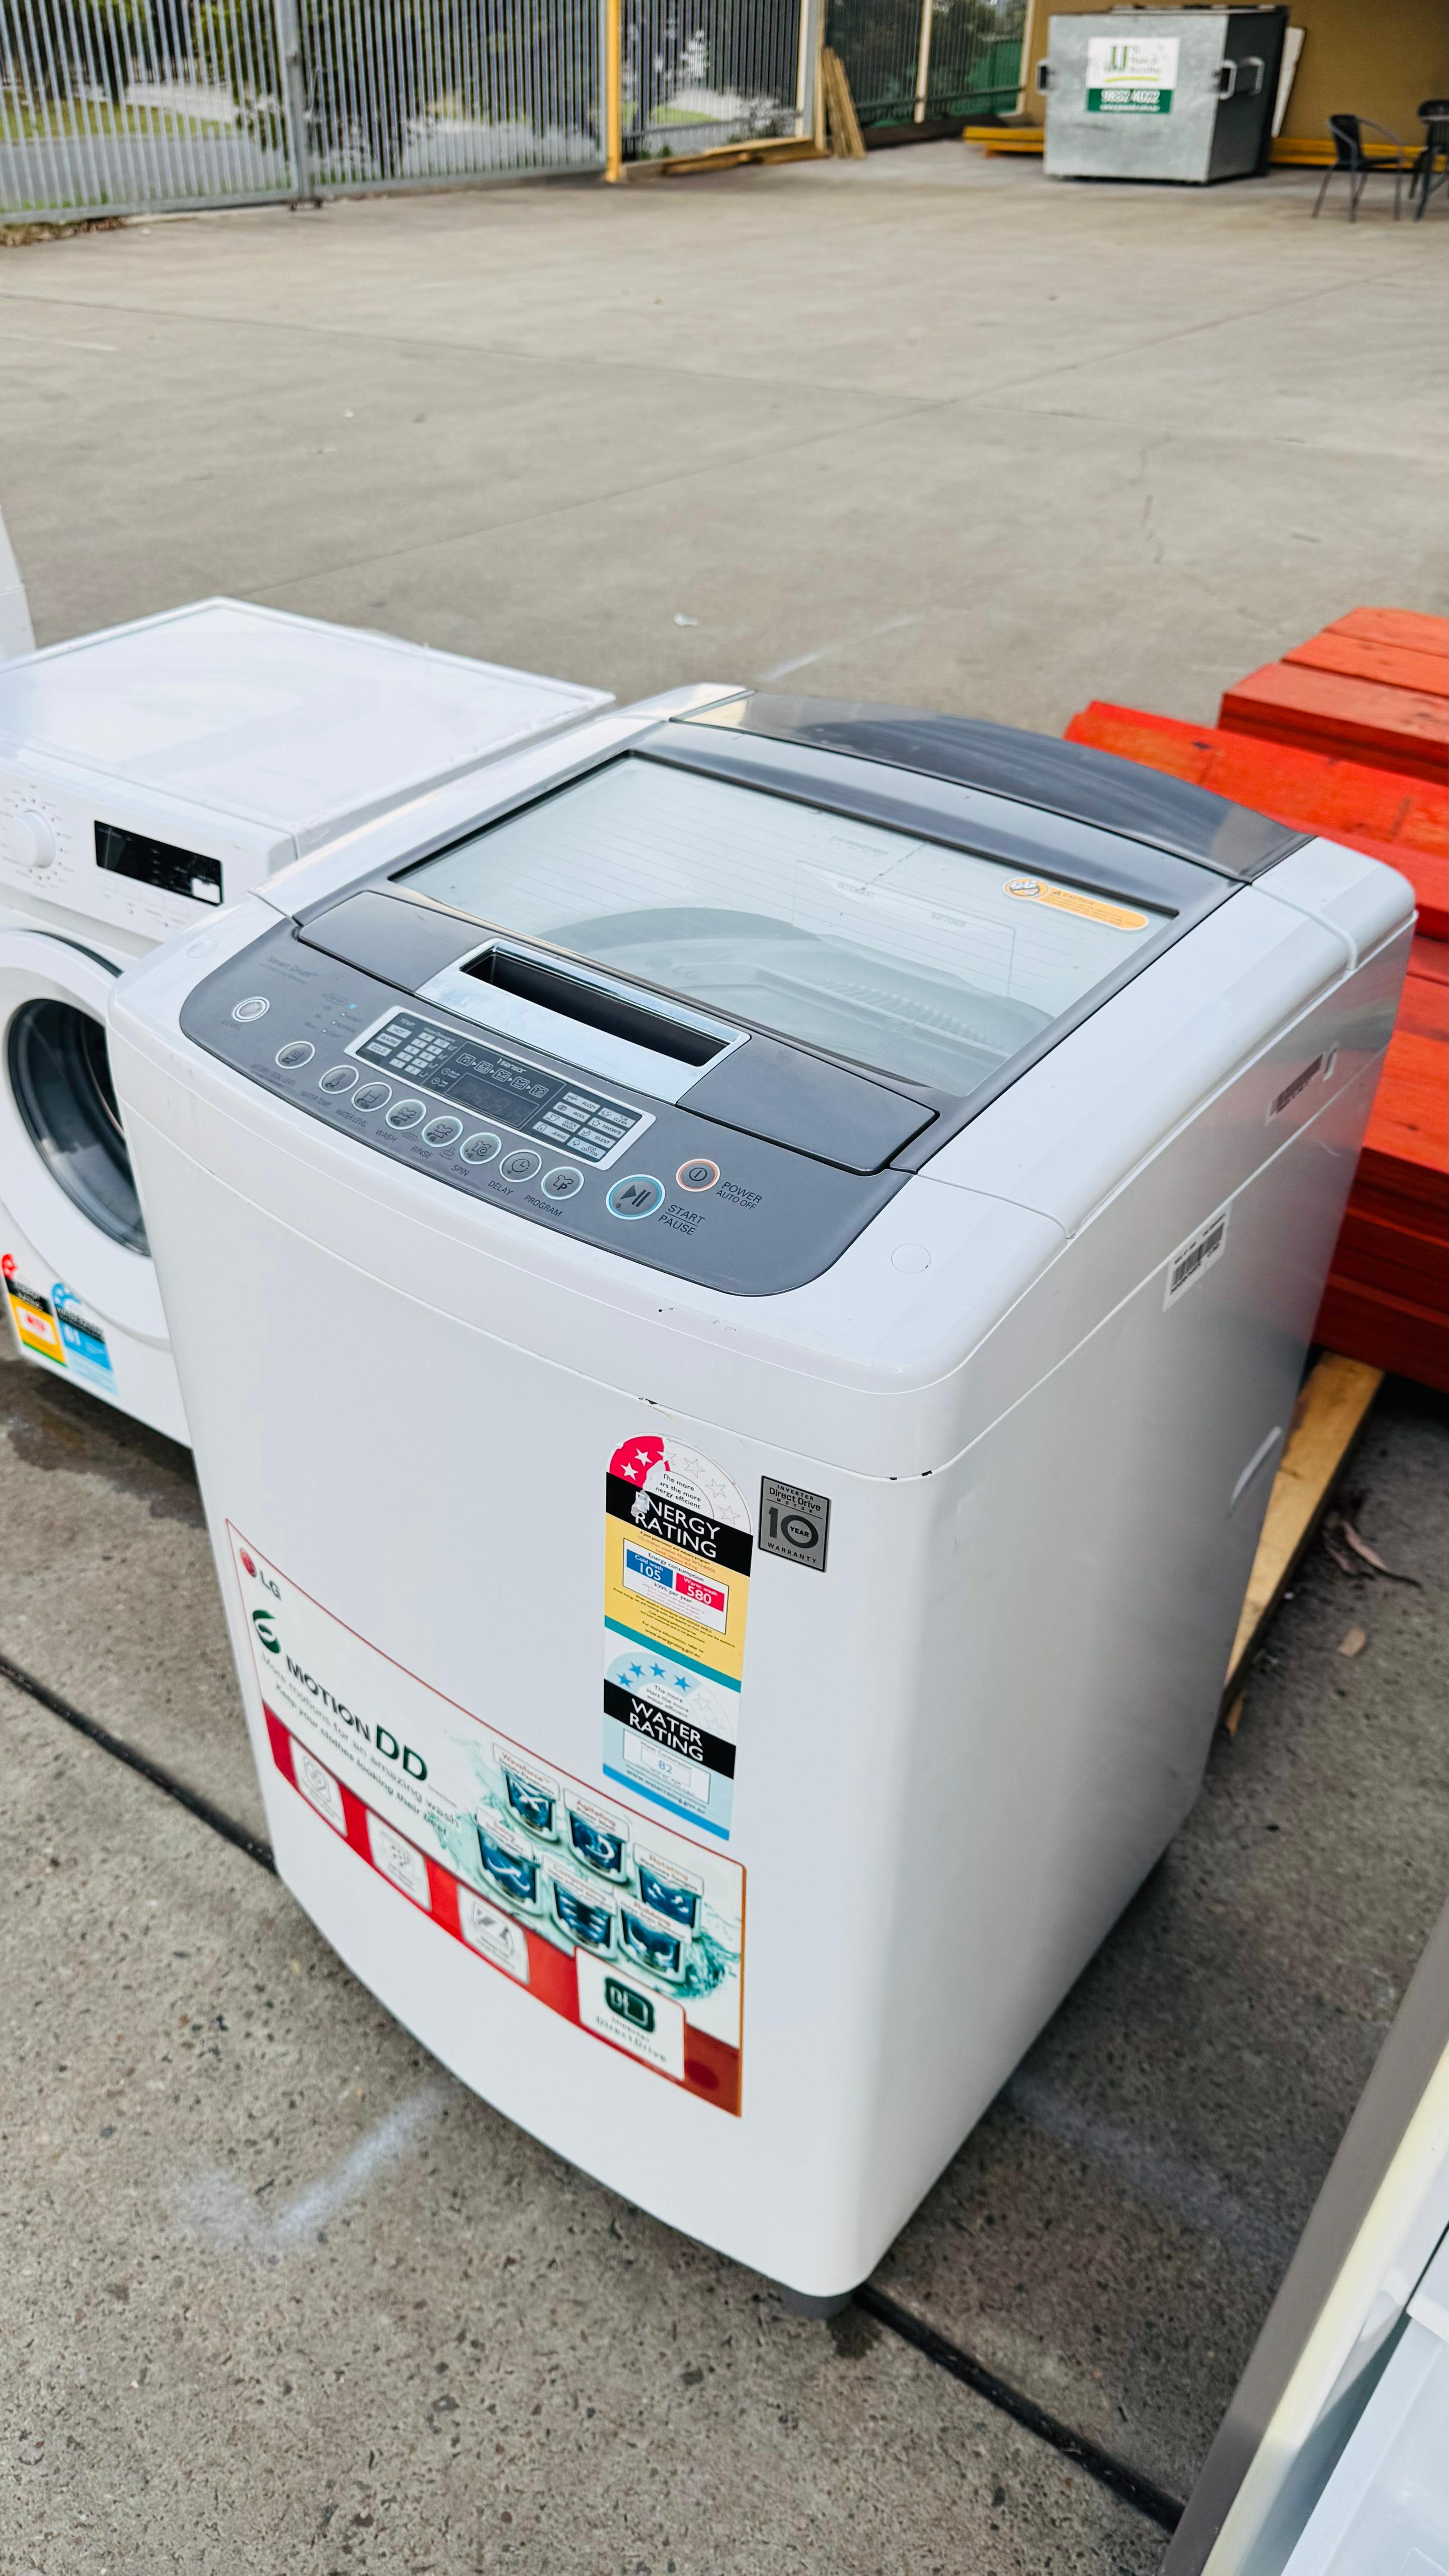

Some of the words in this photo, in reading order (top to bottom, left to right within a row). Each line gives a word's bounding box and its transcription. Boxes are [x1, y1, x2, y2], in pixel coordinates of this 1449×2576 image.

[380, 1034, 398, 1044] WARM
[371, 1045, 387, 1054] COLD
[582, 1101, 596, 1110] FUZZY
[335, 1108, 354, 1122] WATER
[352, 1115, 369, 1128] LEVEL
[573, 1111, 586, 1119] WOOL
[613, 1116, 628, 1125] CLEAN
[375, 1129, 398, 1143] WASH
[551, 1131, 567, 1140] JEANS
[602, 1124, 622, 1135] FAVORITE
[594, 1135, 610, 1145] SILENT
[411, 1146, 434, 1159] RINSE
[581, 1147, 599, 1157] COTTON
[451, 1164, 470, 1177] SPIN
[488, 1180, 514, 1196] DELAY
[721, 1181, 763, 1203] POWER
[523, 1194, 563, 1218] PROGRAM
[715, 1190, 740, 1203] AUTO
[740, 1199, 757, 1210] OFF
[668, 1204, 706, 1224] START
[658, 1215, 697, 1236] PAUSE
[671, 1484, 682, 1494] the
[683, 1492, 701, 1502] more
[677, 1481, 694, 1491] more
[777, 1484, 814, 1501] INVERTER
[656, 1487, 674, 1498] nergy
[675, 1495, 701, 1509] efficient
[769, 1487, 796, 1503] Direct
[798, 1497, 822, 1511] Drive
[777, 1498, 813, 1513] MOTOR
[636, 1491, 720, 1540] NERGY
[635, 1511, 716, 1558] RATING
[769, 1506, 819, 1549] 10
[790, 1525, 810, 1538] YEAR
[768, 1542, 817, 1563] WARRANTY
[634, 1554, 649, 1565] Cold
[650, 1561, 664, 1572] wash
[640, 1563, 661, 1581] 105
[648, 1553, 667, 1566] Energy
[668, 1563, 704, 1582] consumption
[260, 1568, 282, 1601] LG
[654, 1582, 668, 1592] kWh
[683, 1577, 702, 1590] Warm
[703, 1588, 718, 1597] wash
[687, 1585, 712, 1605] 580
[655, 1684, 665, 1694] The
[667, 1692, 683, 1702] more
[673, 1702, 689, 1713] more
[286, 1654, 371, 1742] MOTION
[376, 1724, 428, 1782] DD
[631, 1698, 703, 1746] WATER
[629, 1713, 703, 1761] RATING
[277, 1683, 297, 1708] Keep
[298, 1708, 318, 1728] your
[320, 1728, 354, 1761] clothes
[356, 1759, 394, 1796] looking
[396, 1792, 420, 1815] their
[289, 1683, 331, 1726] motions
[333, 1722, 349, 1741] for
[353, 1741, 367, 1757] an
[371, 1755, 423, 1803] amazing
[426, 1799, 459, 1828] wash
[659, 1759, 673, 1775] 82
